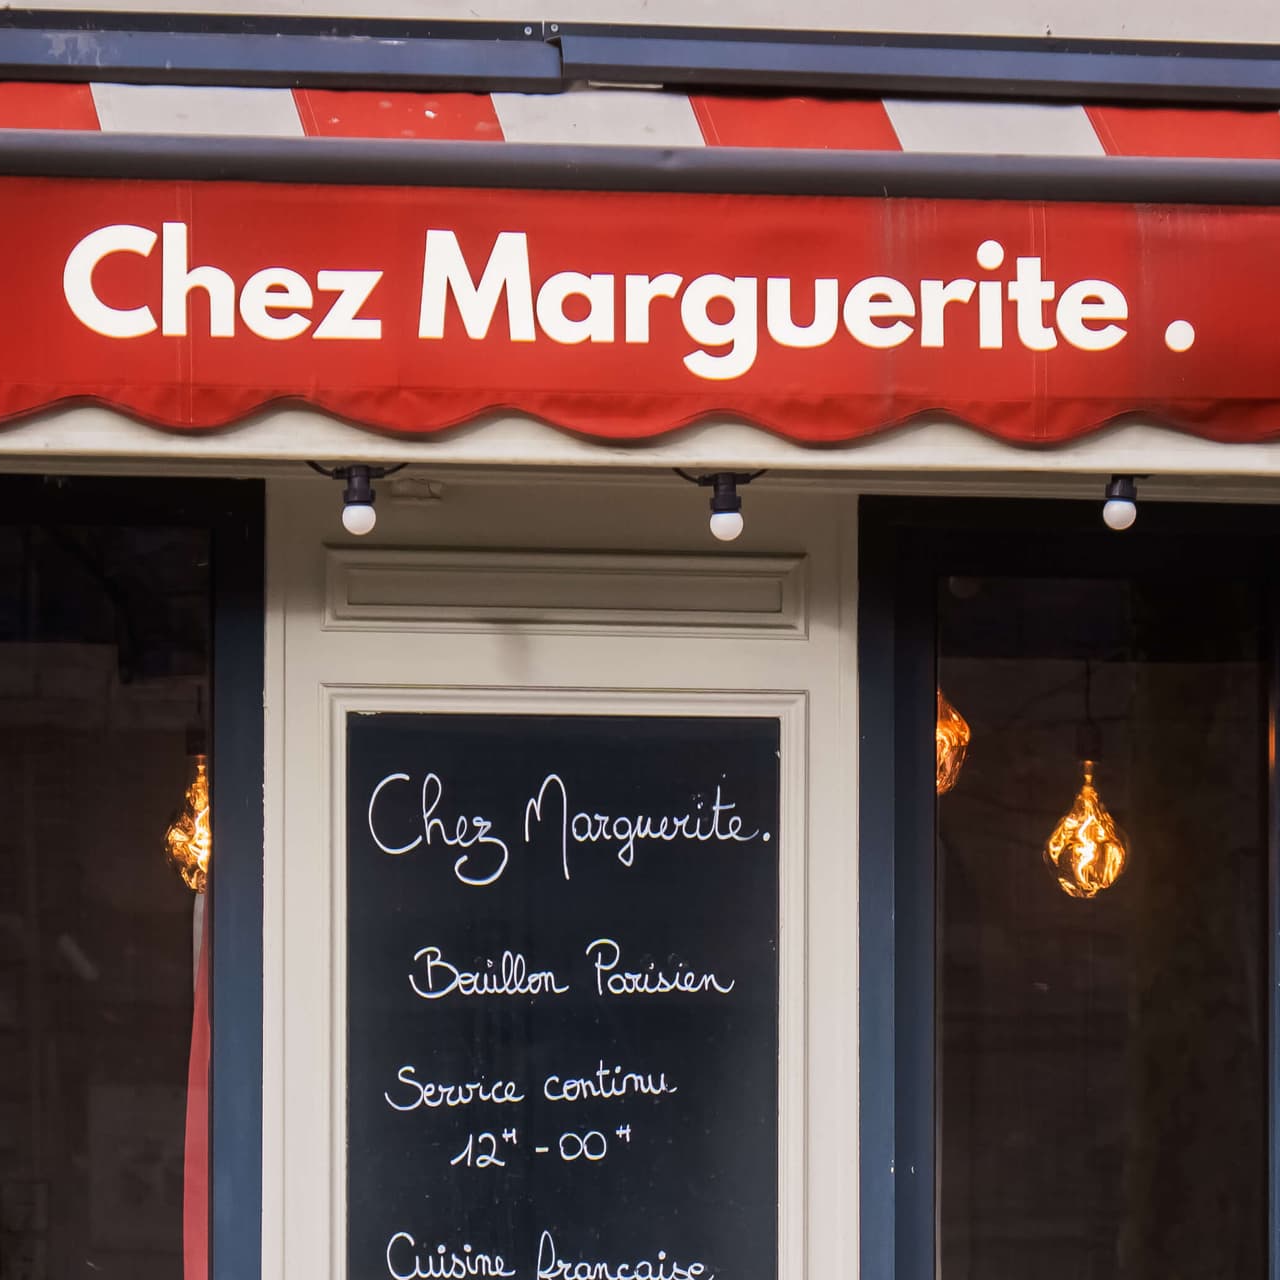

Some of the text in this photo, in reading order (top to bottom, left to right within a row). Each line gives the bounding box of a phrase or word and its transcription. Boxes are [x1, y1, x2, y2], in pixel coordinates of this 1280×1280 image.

[63, 221, 384, 341] Chez
[368, 772, 772, 886] Chez Marguerite.
[408, 938, 736, 999] Bouillon Parisien
[384, 1059, 678, 1112] Service continu
